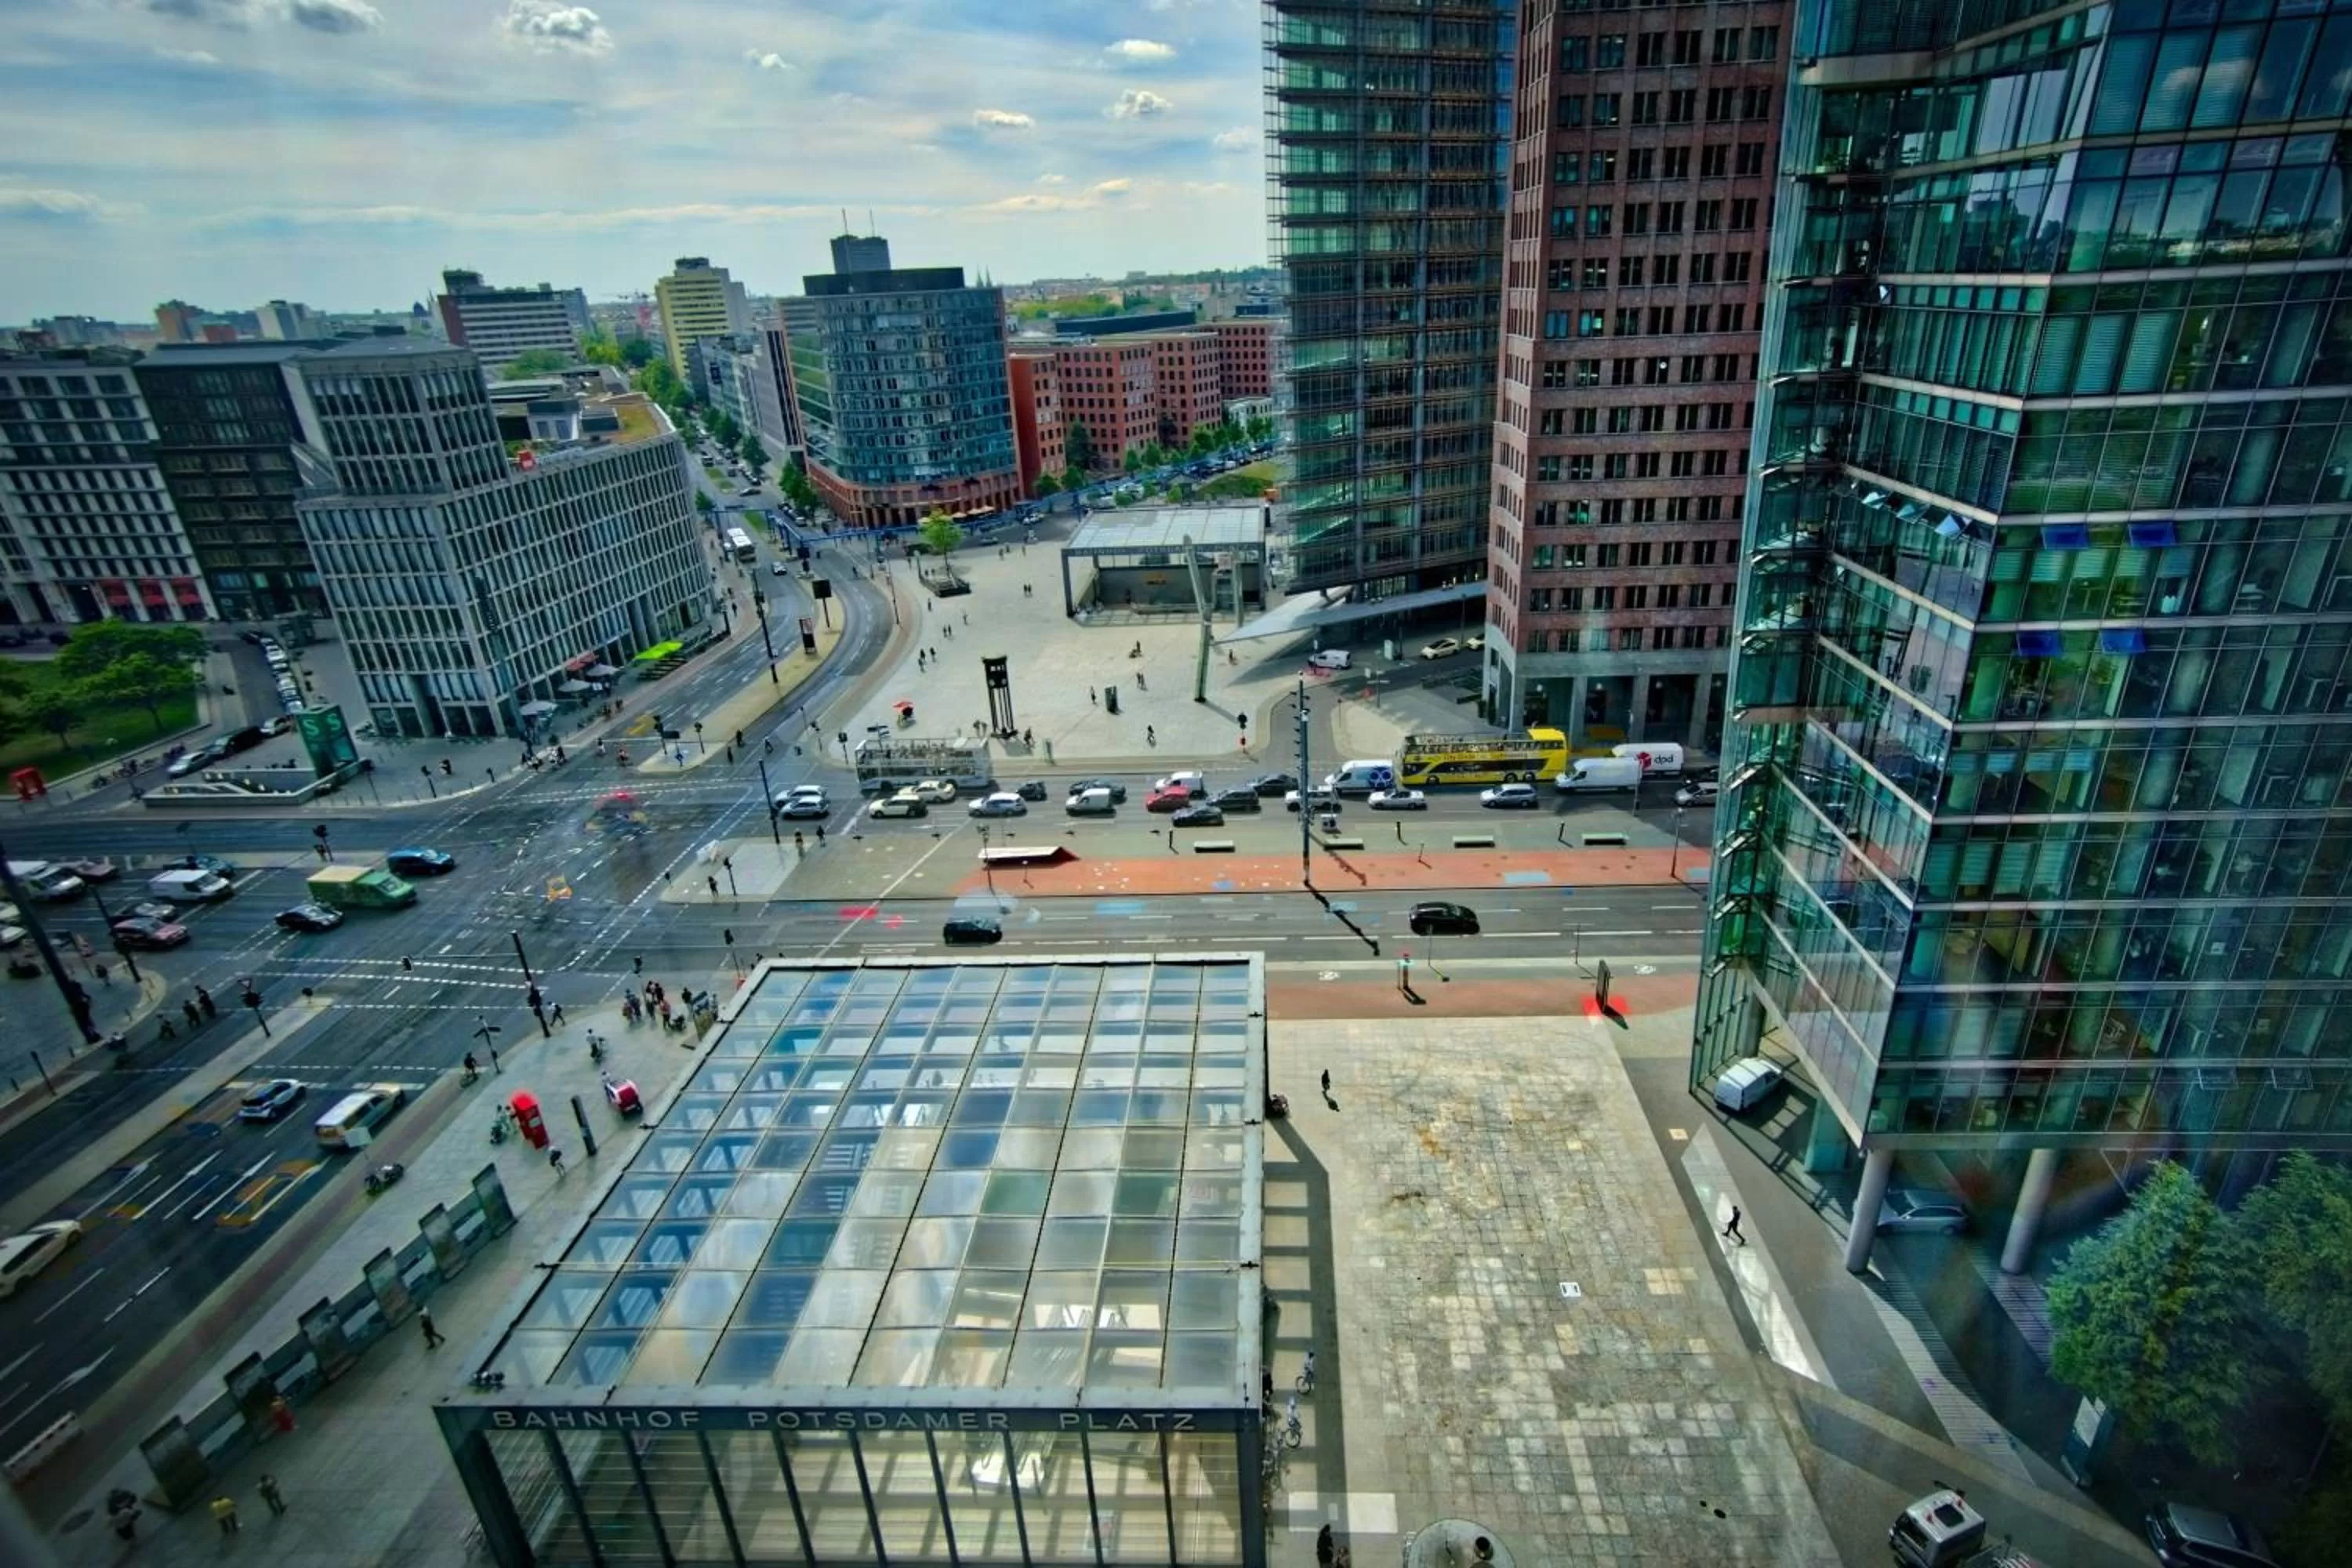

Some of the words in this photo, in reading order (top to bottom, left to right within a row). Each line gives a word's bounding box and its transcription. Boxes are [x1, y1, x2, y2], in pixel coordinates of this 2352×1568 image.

[302, 719, 319, 735] S
[326, 713, 341, 731] S
[1654, 754, 1674, 765] dpd
[492, 1410, 701, 1428] BAHNHOF
[747, 1411, 1009, 1428] POTSDAMER
[1059, 1413, 1196, 1430] PLATZ
